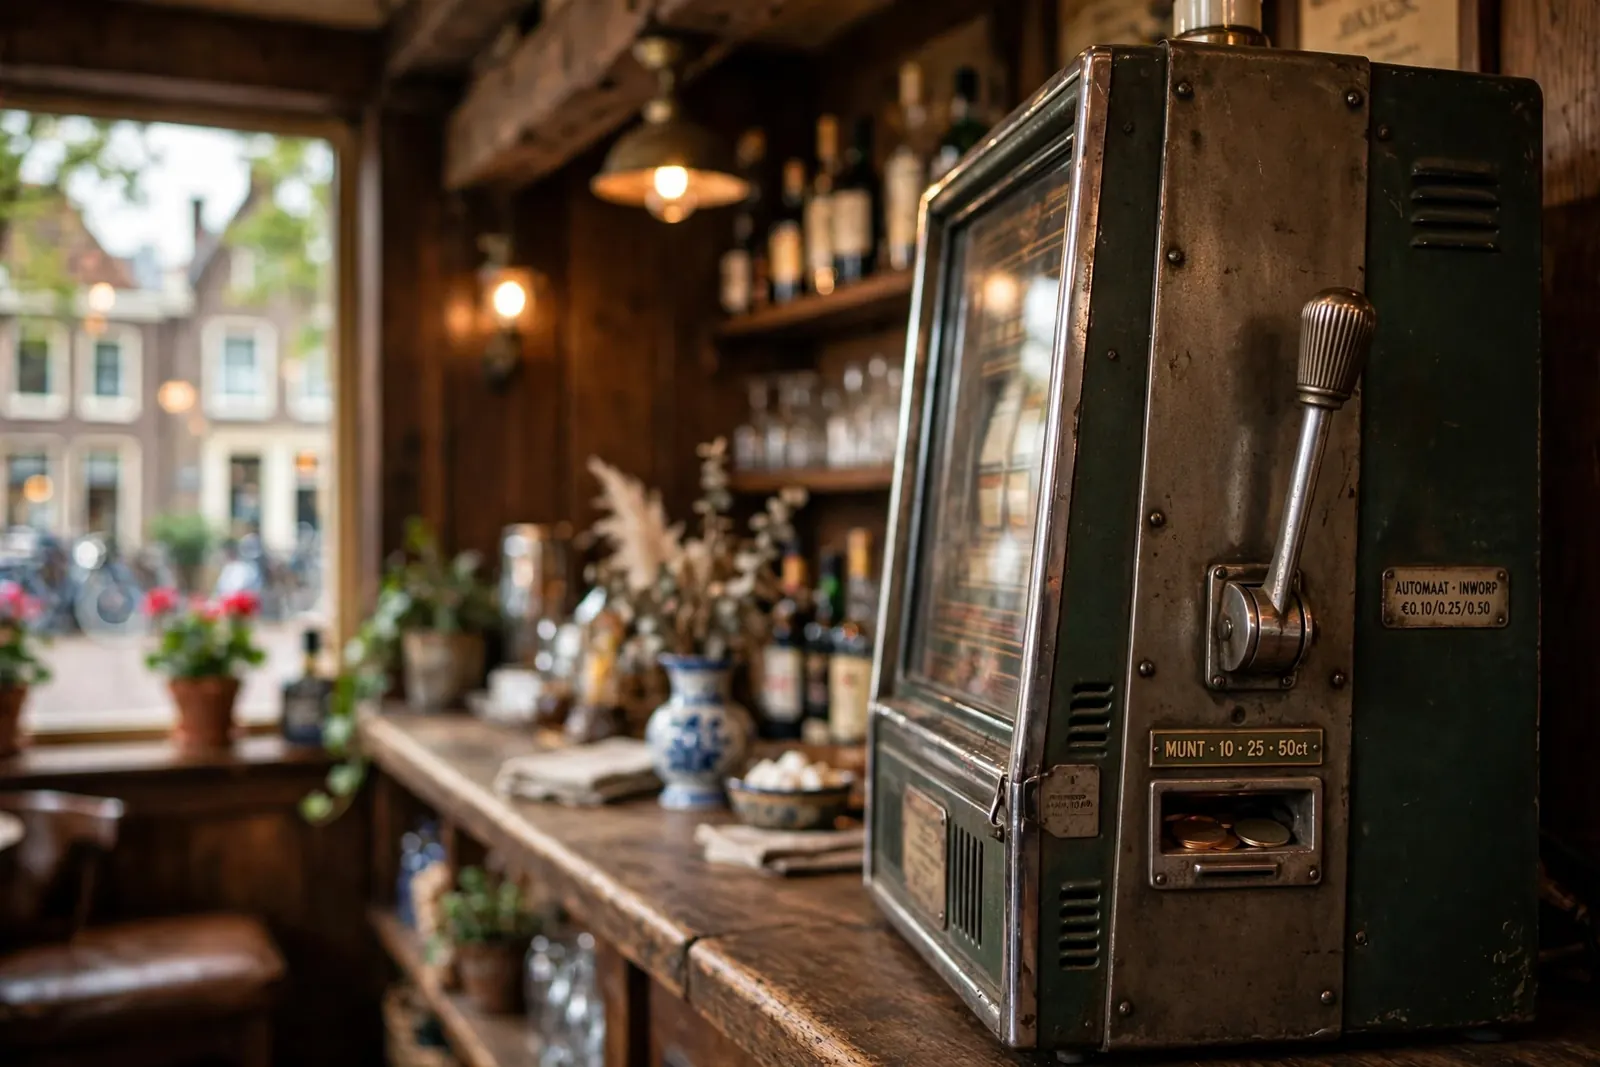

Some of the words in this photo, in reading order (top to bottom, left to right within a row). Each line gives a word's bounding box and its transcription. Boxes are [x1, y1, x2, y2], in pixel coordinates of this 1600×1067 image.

[1395, 581, 1449, 595] AUTOMAAT
[1459, 581, 1498, 595] INWORP
[1401, 600, 1490, 616] €0.10/0.25/0.50
[1165, 741, 1205, 757] MUNT
[1219, 740, 1233, 756] 10
[1247, 740, 1264, 756] 25
[1279, 739, 1308, 756] 50ct
